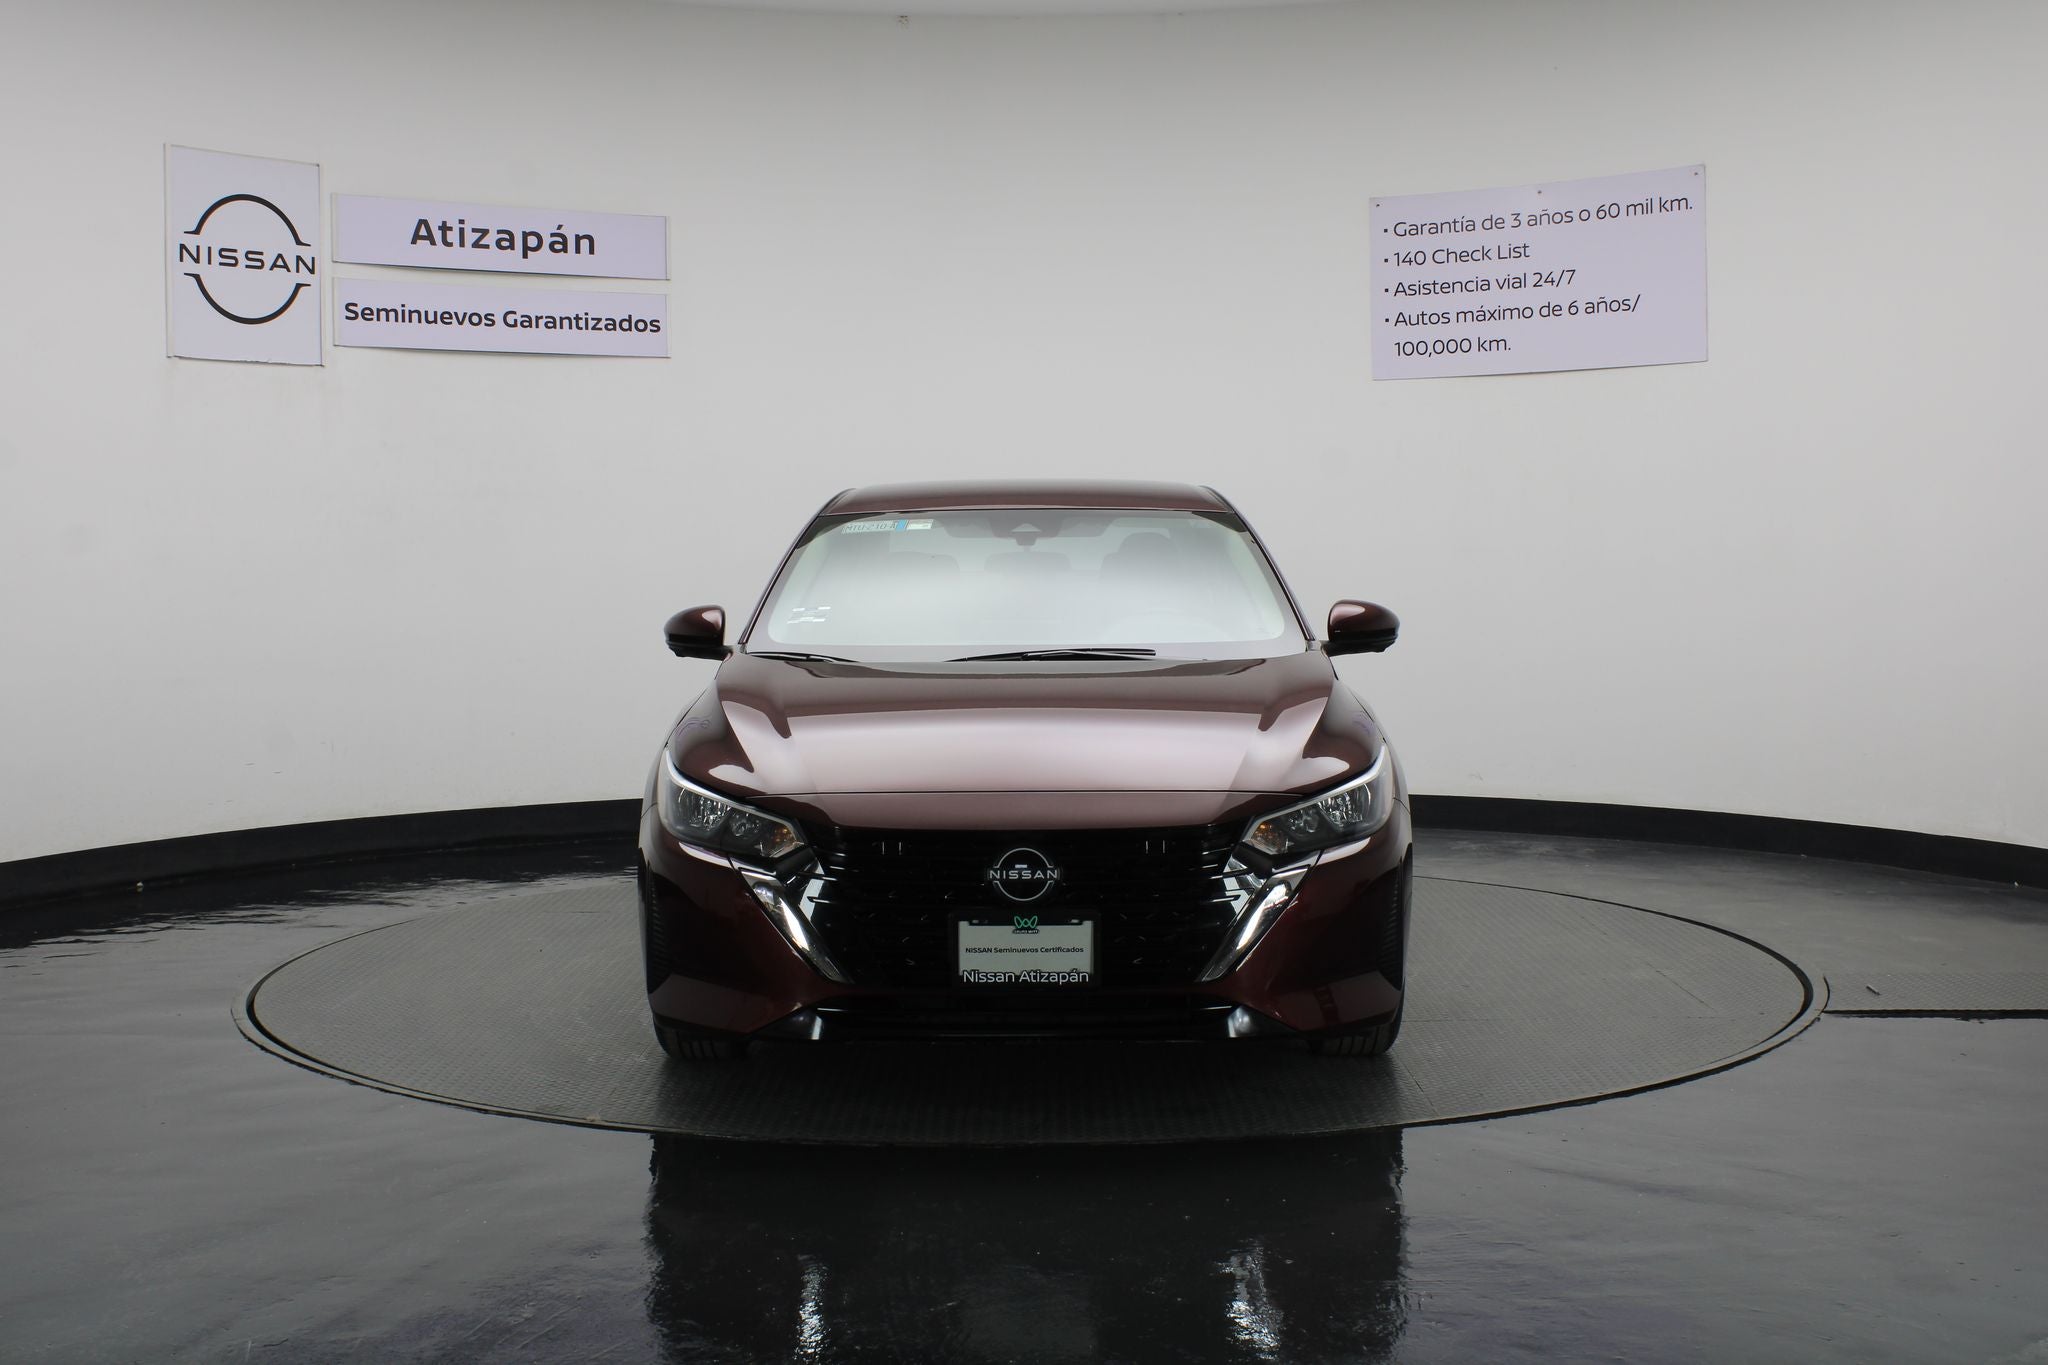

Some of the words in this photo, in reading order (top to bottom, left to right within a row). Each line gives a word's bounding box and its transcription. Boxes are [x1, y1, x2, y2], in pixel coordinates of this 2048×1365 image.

[1393, 215, 1476, 237] Garantía
[1481, 214, 1505, 231] de
[1510, 212, 1522, 229] 3
[1527, 209, 1574, 227] años
[1578, 208, 1591, 222] o
[1596, 202, 1621, 220] 60
[1626, 197, 1653, 217] mil
[1659, 196, 1693, 213] km.
[410, 218, 595, 260] Atizapán
[179, 243, 316, 275] NISSAN
[1393, 250, 1427, 267] 140
[1431, 245, 1492, 265] Check
[1497, 243, 1530, 260] List
[1393, 277, 1491, 297] Asistencia
[1495, 272, 1527, 290] vial
[1532, 269, 1576, 288] 24/7
[344, 302, 496, 328] Seminuevos
[502, 310, 661, 334] Garantizados
[1393, 310, 1451, 327] Autos
[1456, 304, 1534, 324] máximo
[1538, 301, 1563, 318] de
[1567, 299, 1579, 316] 6
[1584, 293, 1641, 315] años/
[1394, 337, 1472, 358] 100,000
[1477, 336, 1512, 353] km.
[989, 869, 1059, 880] NISSAN
[993, 946, 1039, 954] Seminuevos
[963, 970, 1015, 983] Nissan
[1019, 968, 1089, 985] Atizapán
